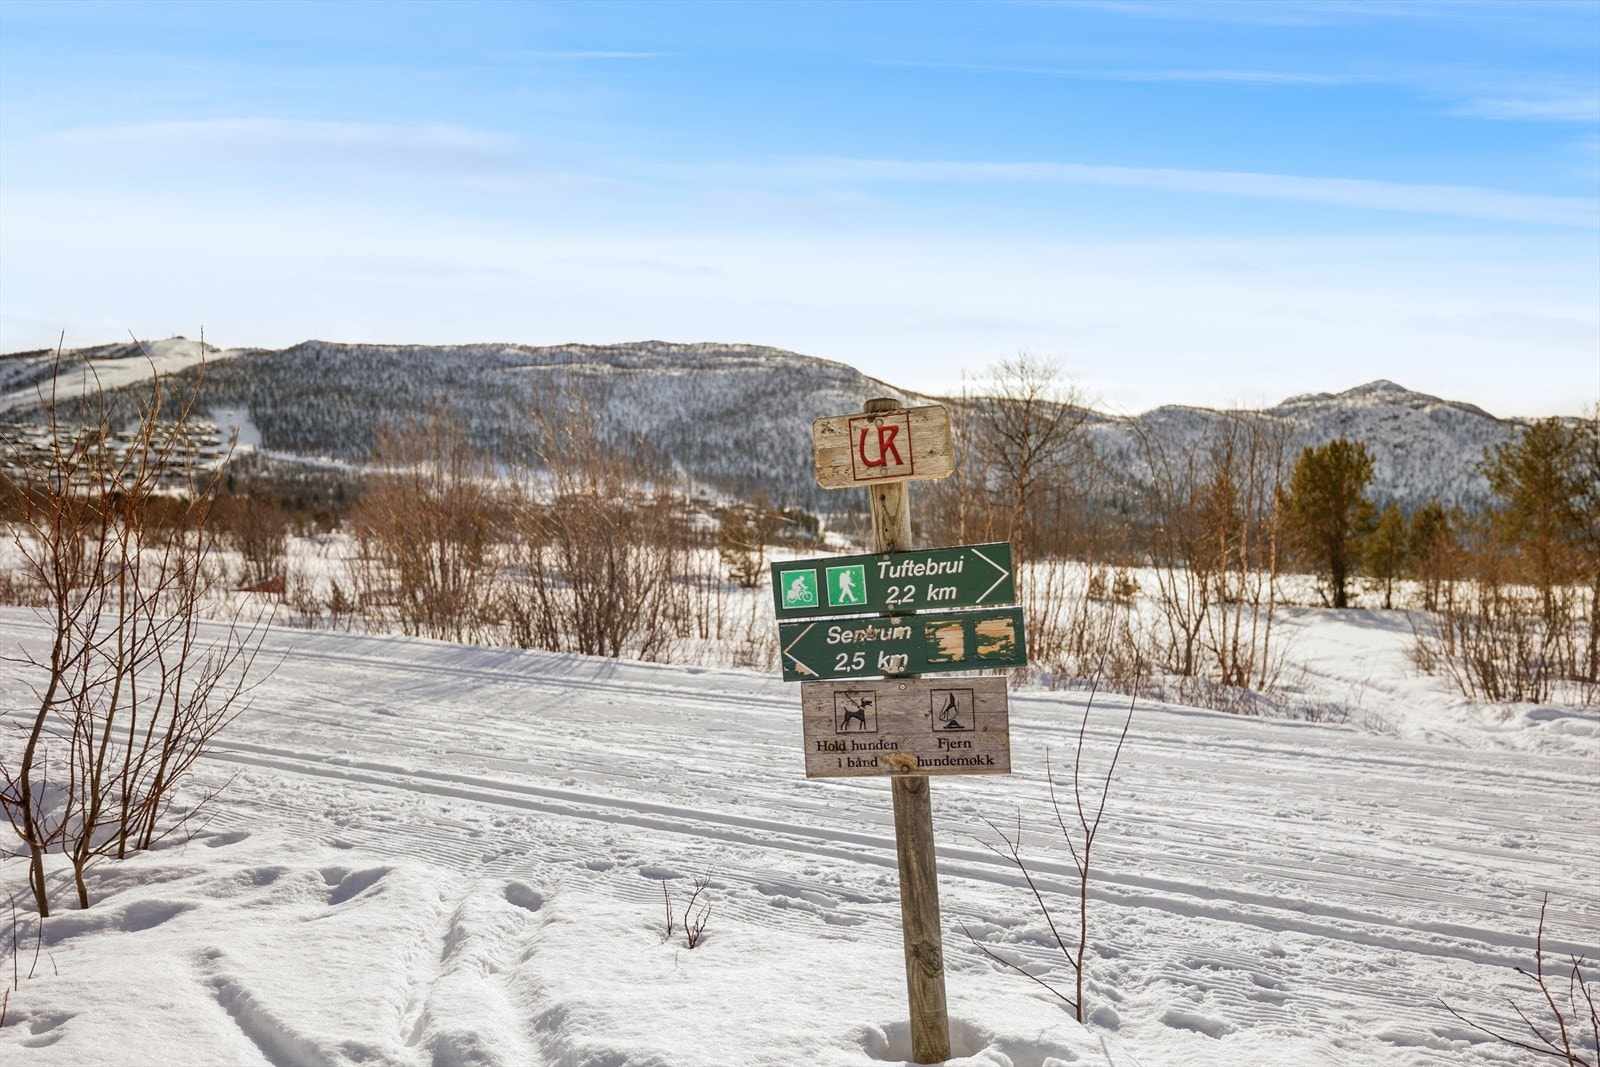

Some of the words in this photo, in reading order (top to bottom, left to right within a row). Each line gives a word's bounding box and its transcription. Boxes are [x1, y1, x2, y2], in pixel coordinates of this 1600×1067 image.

[877, 555, 965, 579] Tuftebrui
[927, 584, 957, 601] km
[826, 625, 912, 644] Sentrum
[877, 650, 909, 669] km
[816, 740, 846, 752] Hold
[852, 739, 898, 751] hunden
[936, 737, 972, 753] Fjern
[838, 757, 842, 767] i
[847, 756, 878, 767] bånd
[916, 754, 995, 766] hundemøkk
